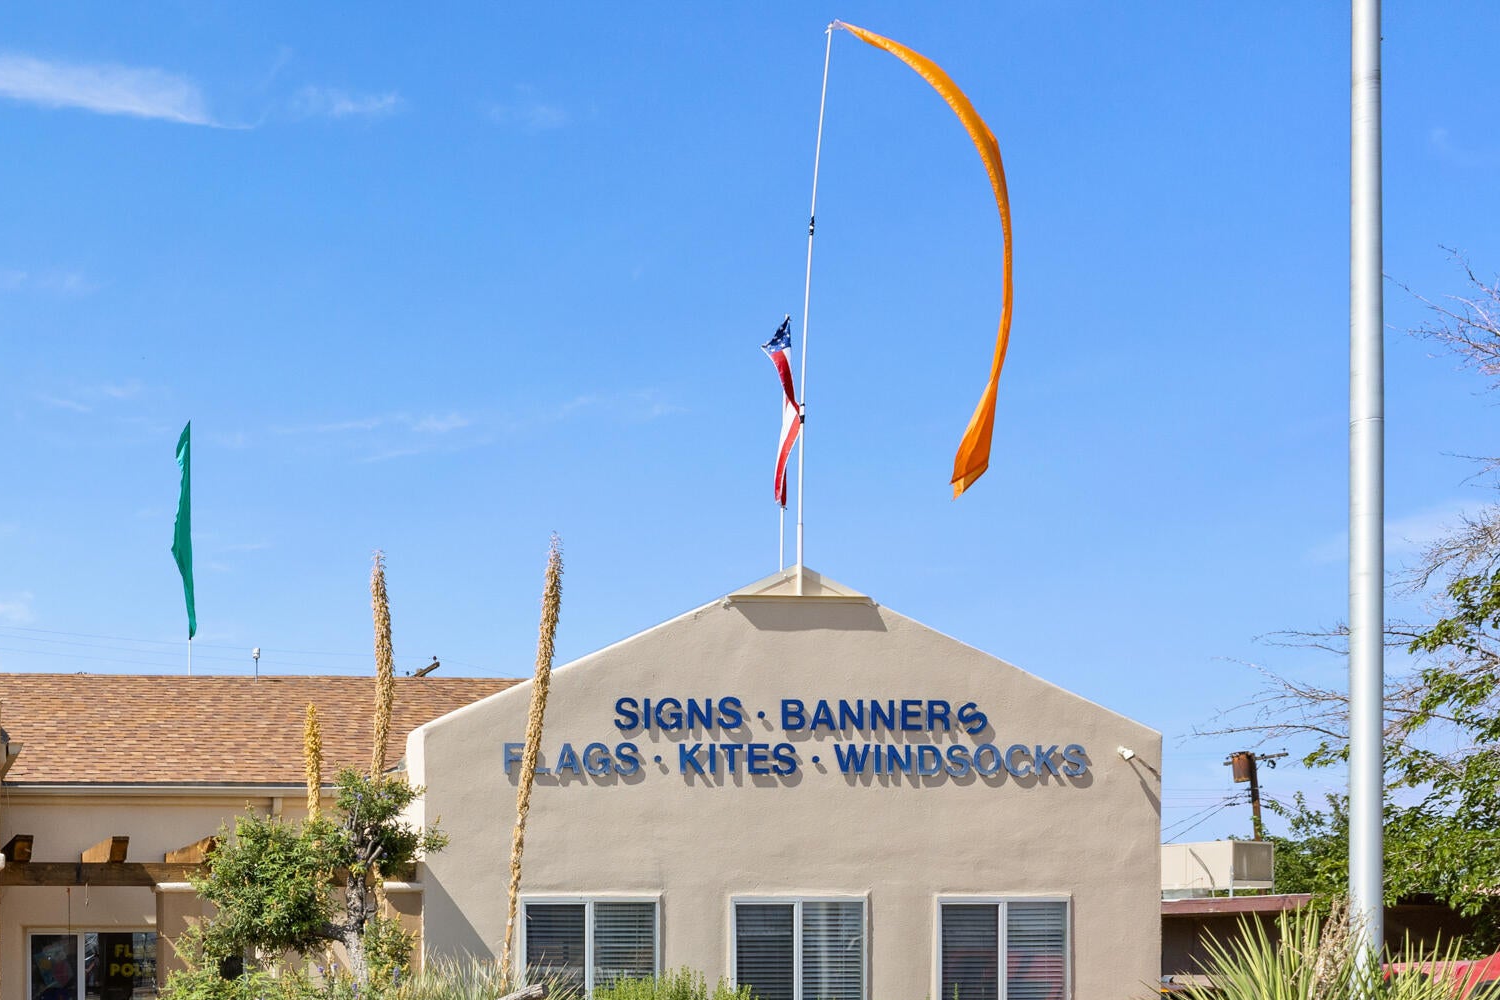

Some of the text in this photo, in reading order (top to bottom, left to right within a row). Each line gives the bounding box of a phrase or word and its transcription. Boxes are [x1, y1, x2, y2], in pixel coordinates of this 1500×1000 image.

[614, 696, 988, 735] SIGNS BANNERS
[679, 743, 797, 776] KITES
[834, 743, 1087, 777] WINDSOCKS
